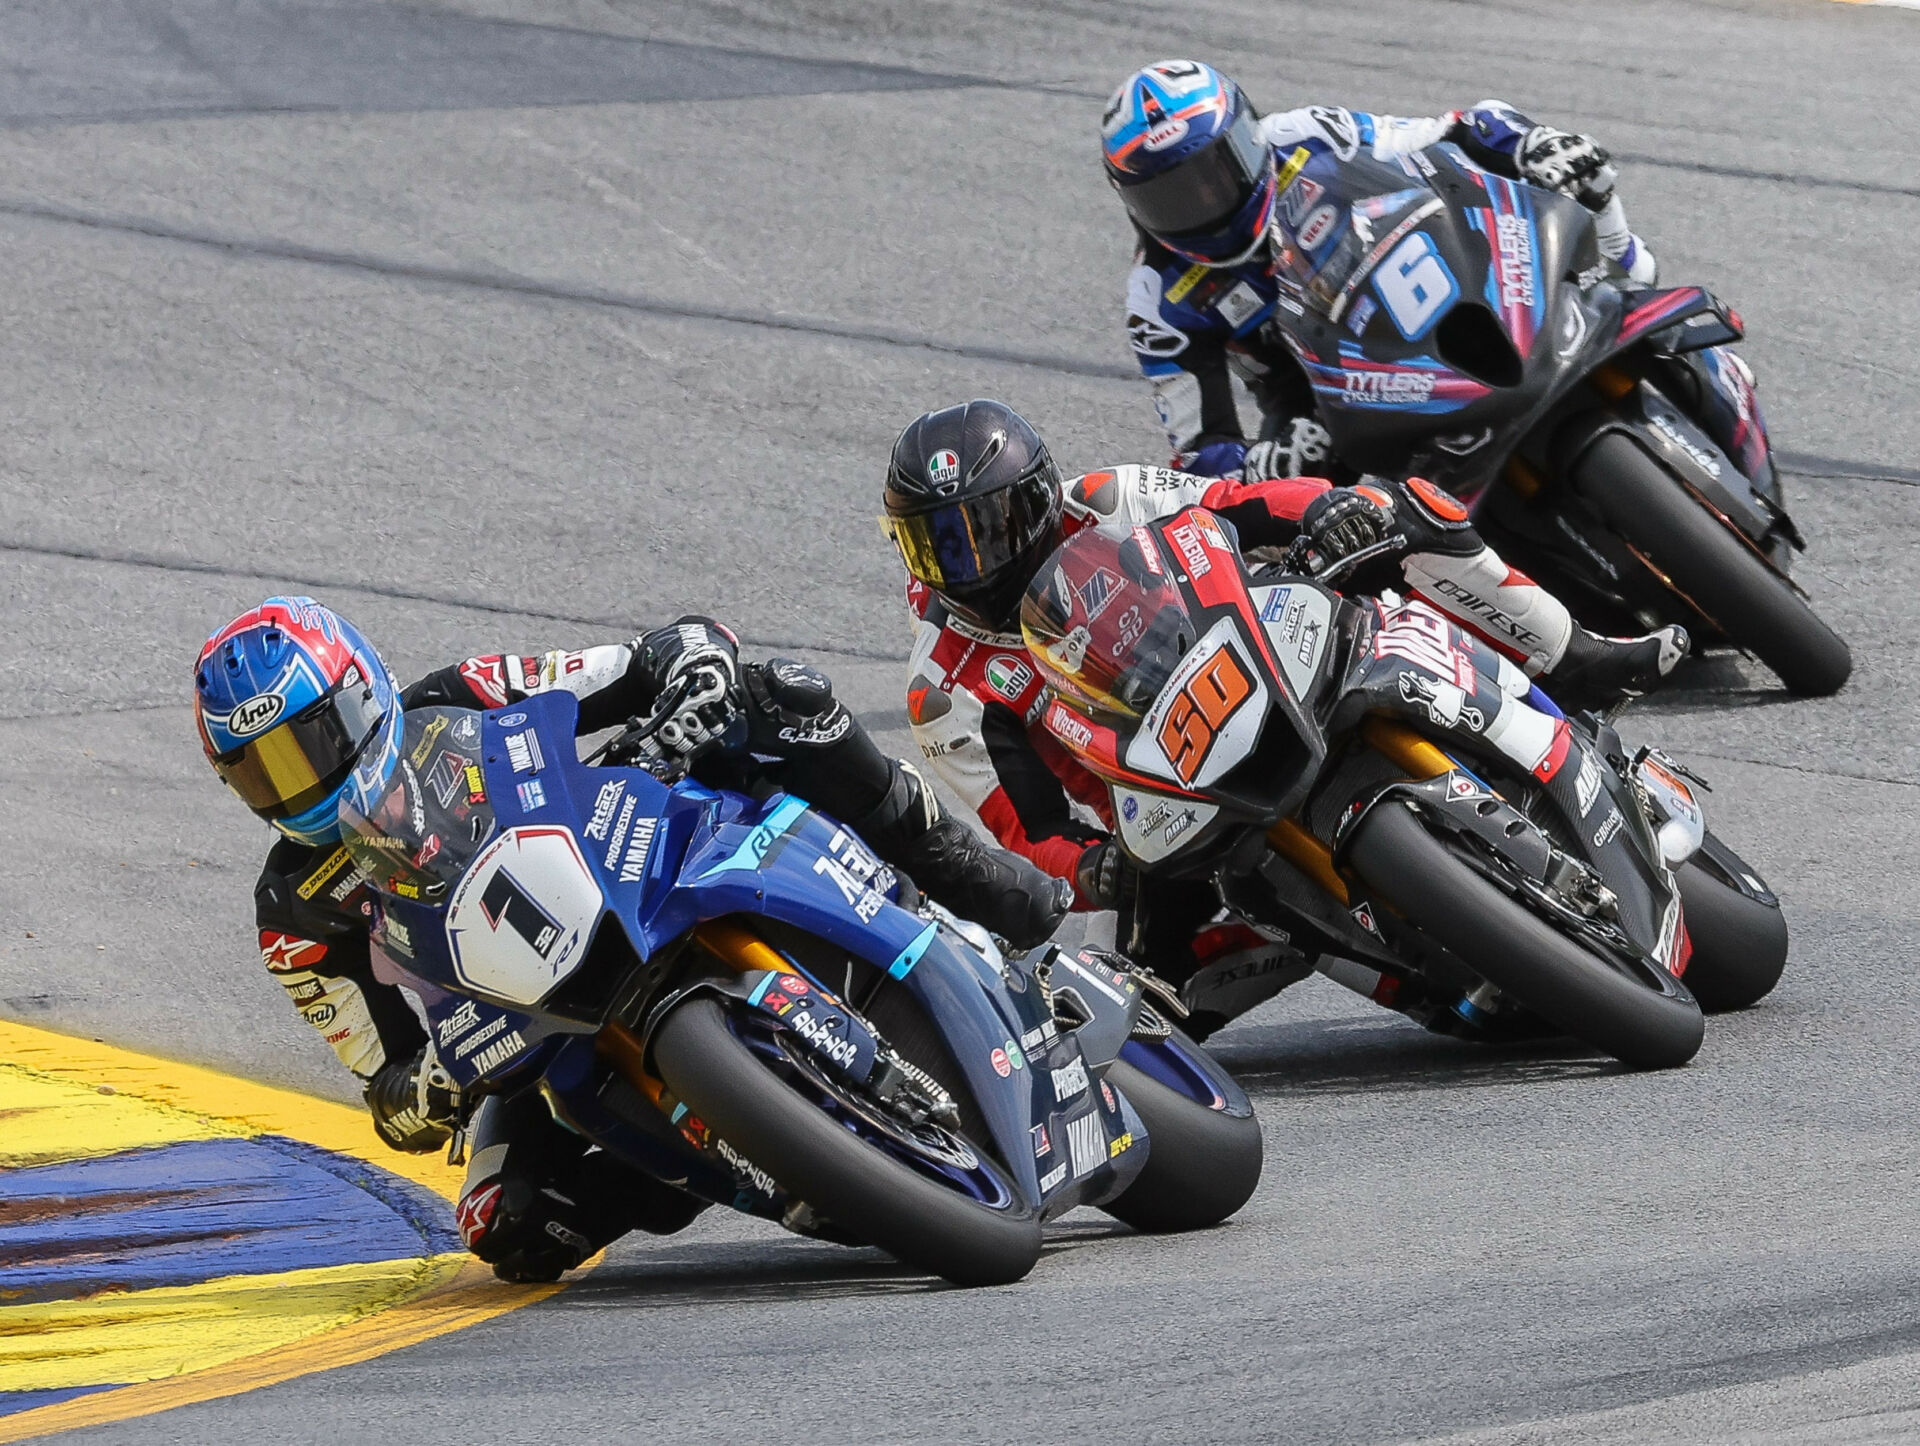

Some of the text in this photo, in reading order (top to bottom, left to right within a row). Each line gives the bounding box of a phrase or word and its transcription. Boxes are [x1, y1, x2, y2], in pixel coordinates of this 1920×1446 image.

[1496, 214, 1524, 307] TYTLERS
[1516, 218, 1532, 263] RACING
[1373, 232, 1458, 340] 6
[1344, 372, 1436, 393] TYTLERS
[933, 465, 958, 482] agv
[1172, 526, 1212, 580] WRENCH
[1281, 600, 1308, 643] Attack
[1433, 579, 1541, 646] DAINESE
[1004, 667, 1029, 696] agv
[234, 696, 275, 732] Arai
[1052, 705, 1093, 747] WRENCH
[1157, 642, 1256, 787] 50
[504, 733, 533, 773] YAMALUBE
[584, 779, 627, 840] Attack
[598, 785, 625, 841] PERFORMANCE
[604, 793, 638, 871] PROGRESSIVE
[310, 850, 348, 888] DUNLOP
[619, 818, 657, 882] YAMAHA
[480, 865, 565, 960] 1
[533, 926, 557, 954] 32
[437, 1000, 482, 1042] Attack
[470, 1030, 527, 1076] YAMAHA
